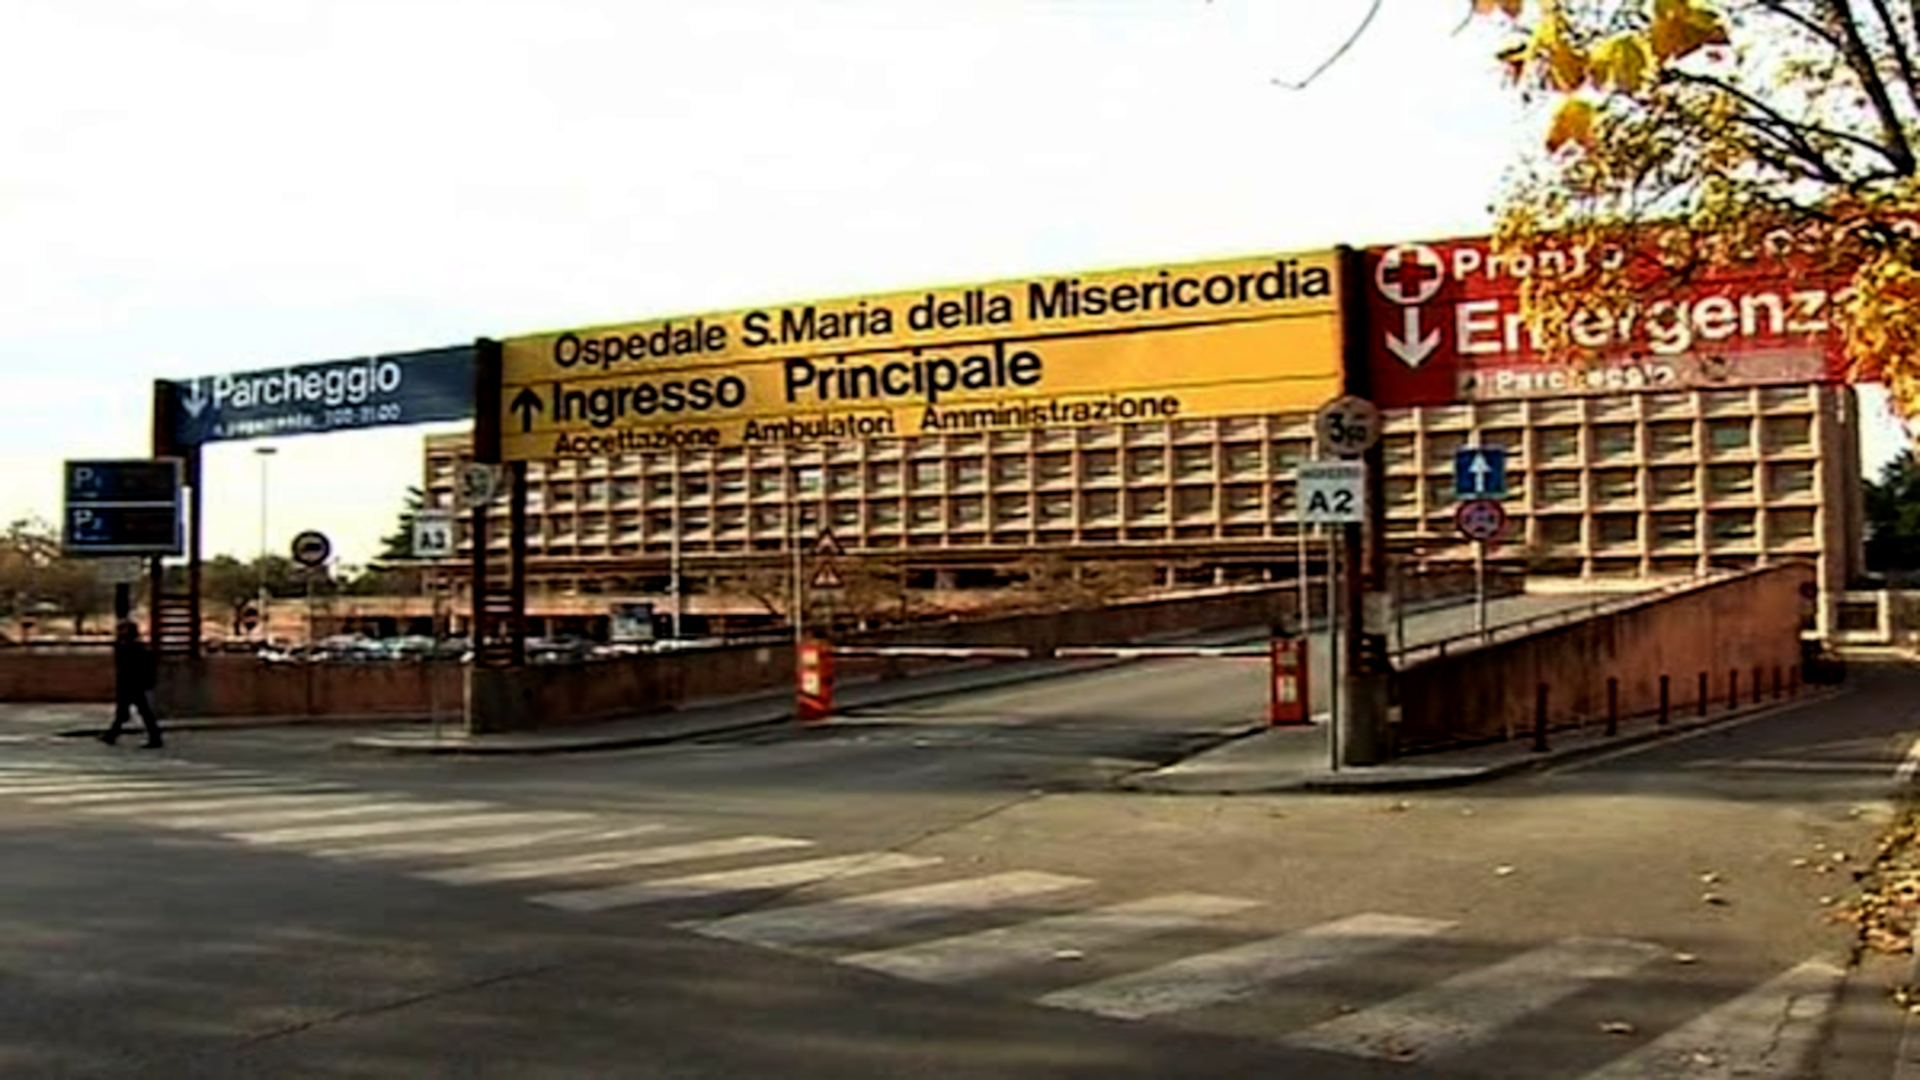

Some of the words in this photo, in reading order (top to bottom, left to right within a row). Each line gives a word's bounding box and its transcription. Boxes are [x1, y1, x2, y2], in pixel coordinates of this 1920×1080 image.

[554, 319, 727, 370] Ospedale
[741, 301, 893, 347] S.Maria
[908, 291, 1012, 332] della
[1028, 259, 1331, 322] Misericordia
[1454, 286, 1855, 354] Emergenz
[212, 359, 402, 411] Parcheggio
[553, 375, 746, 427] Ingresso
[784, 345, 1042, 403] Principale
[555, 423, 721, 453] Accettazione
[920, 394, 1181, 431] Amministrazione
[1308, 489, 1355, 515] A2
